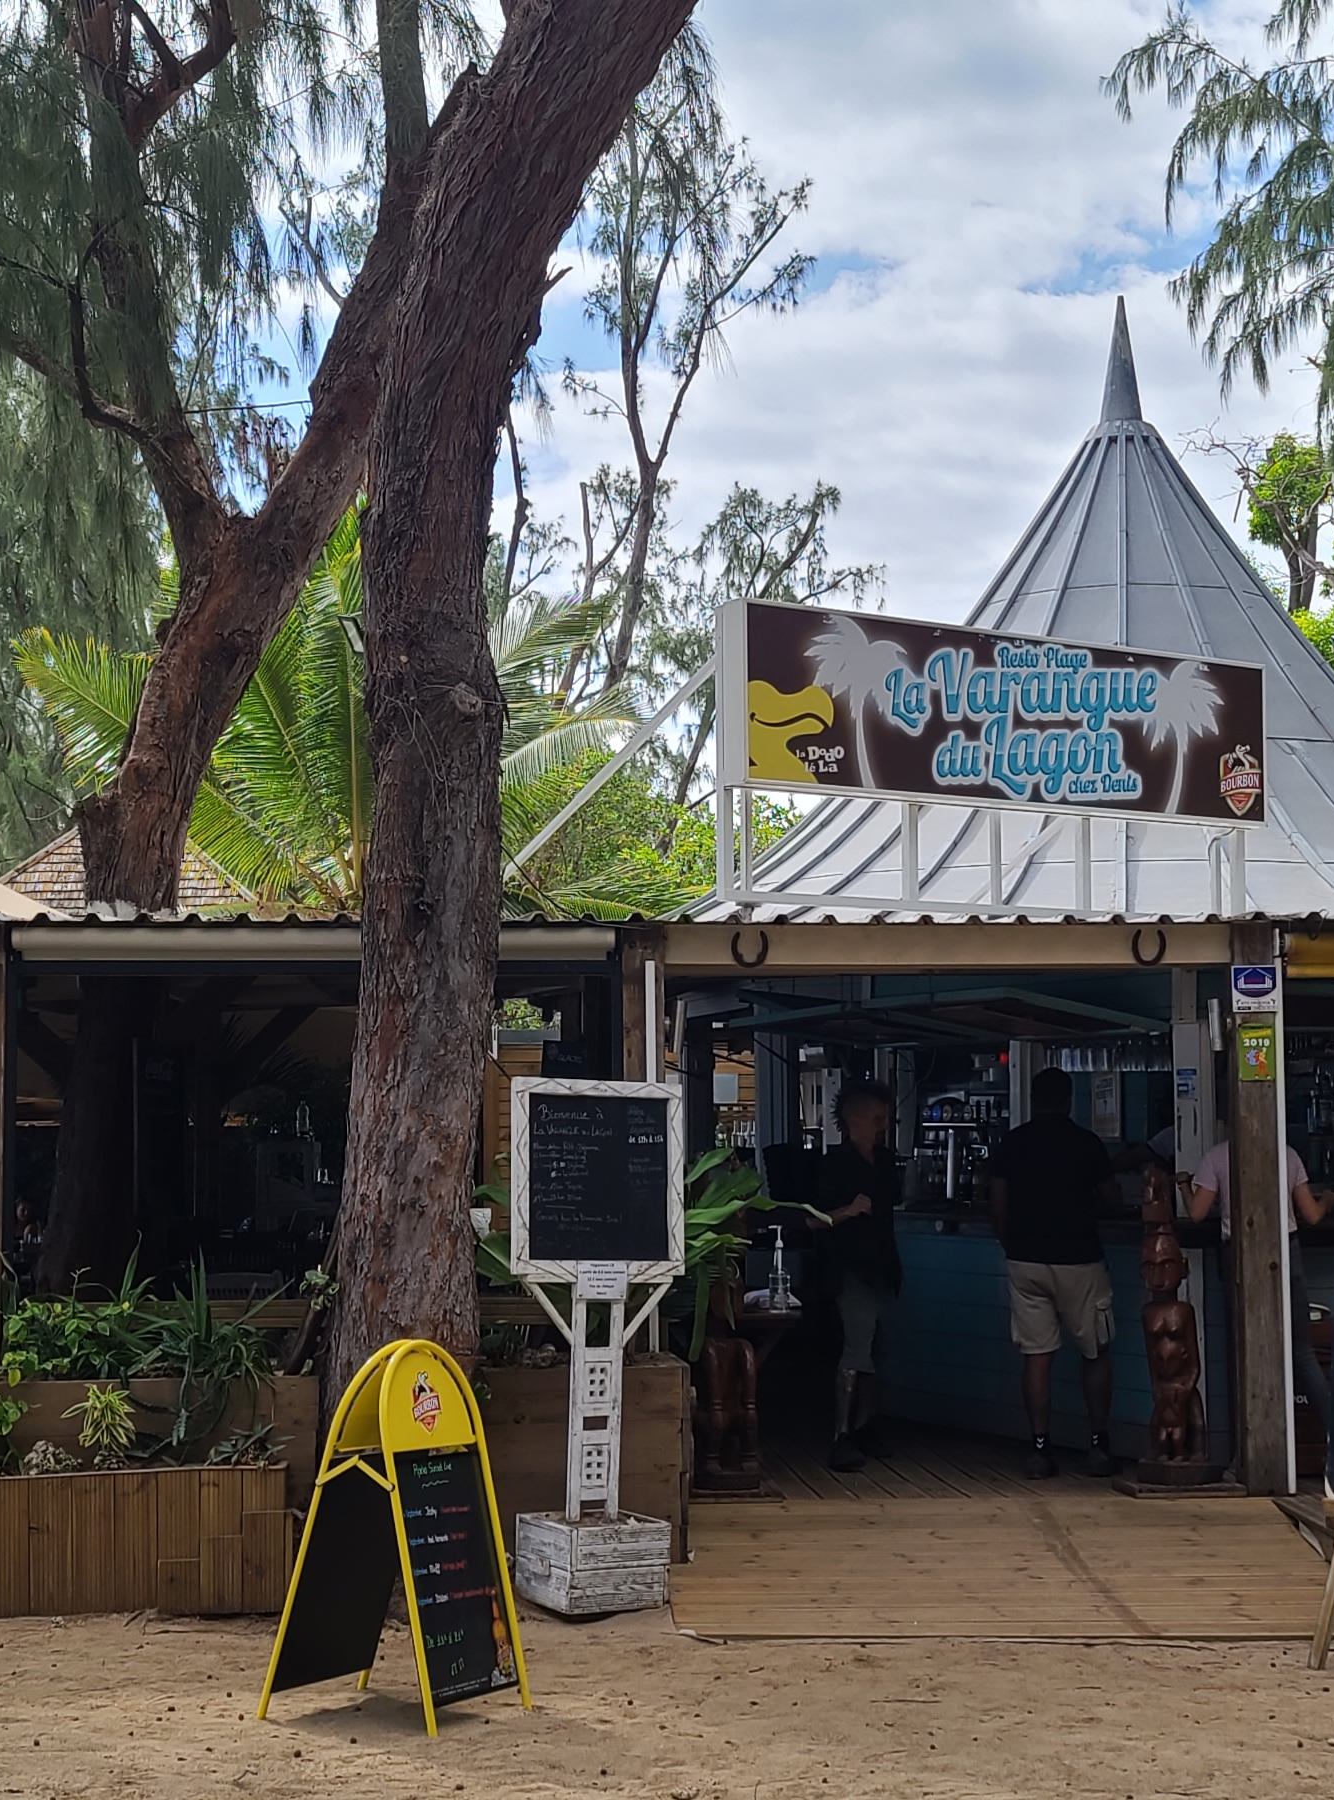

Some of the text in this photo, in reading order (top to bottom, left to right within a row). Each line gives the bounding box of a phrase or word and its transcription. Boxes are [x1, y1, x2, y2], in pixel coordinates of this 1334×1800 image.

[998, 646, 1088, 674] Resto Plage
[885, 651, 1158, 732] La Varangue
[936, 714, 1122, 795] du Lagon
[1068, 773, 1138, 794] chez Denis
[1220, 773, 1260, 793] BOURBON
[1243, 1038, 1270, 1047] 2019
[537, 1103, 604, 1121] Bienvenue à
